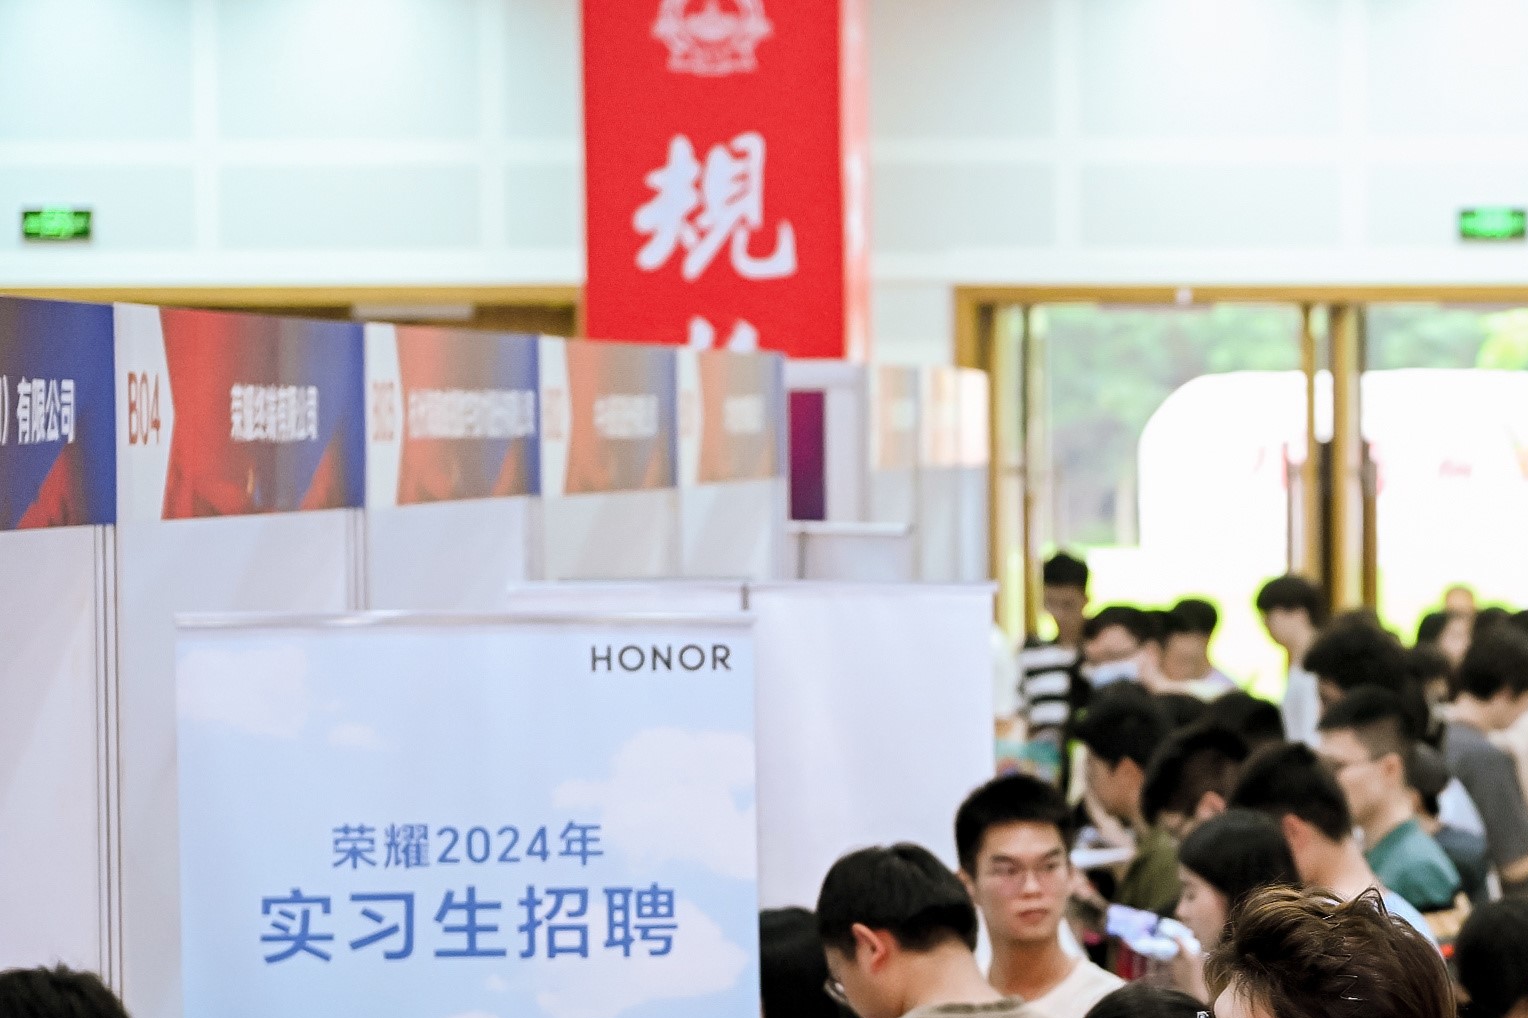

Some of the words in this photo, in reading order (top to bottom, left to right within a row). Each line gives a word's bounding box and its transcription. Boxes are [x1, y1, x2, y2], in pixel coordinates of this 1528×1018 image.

[128, 371, 161, 445] B04
[591, 644, 732, 672] HONOR
[332, 820, 604, 870] 荣耀2024年
[259, 882, 679, 965] 实习生招聘
